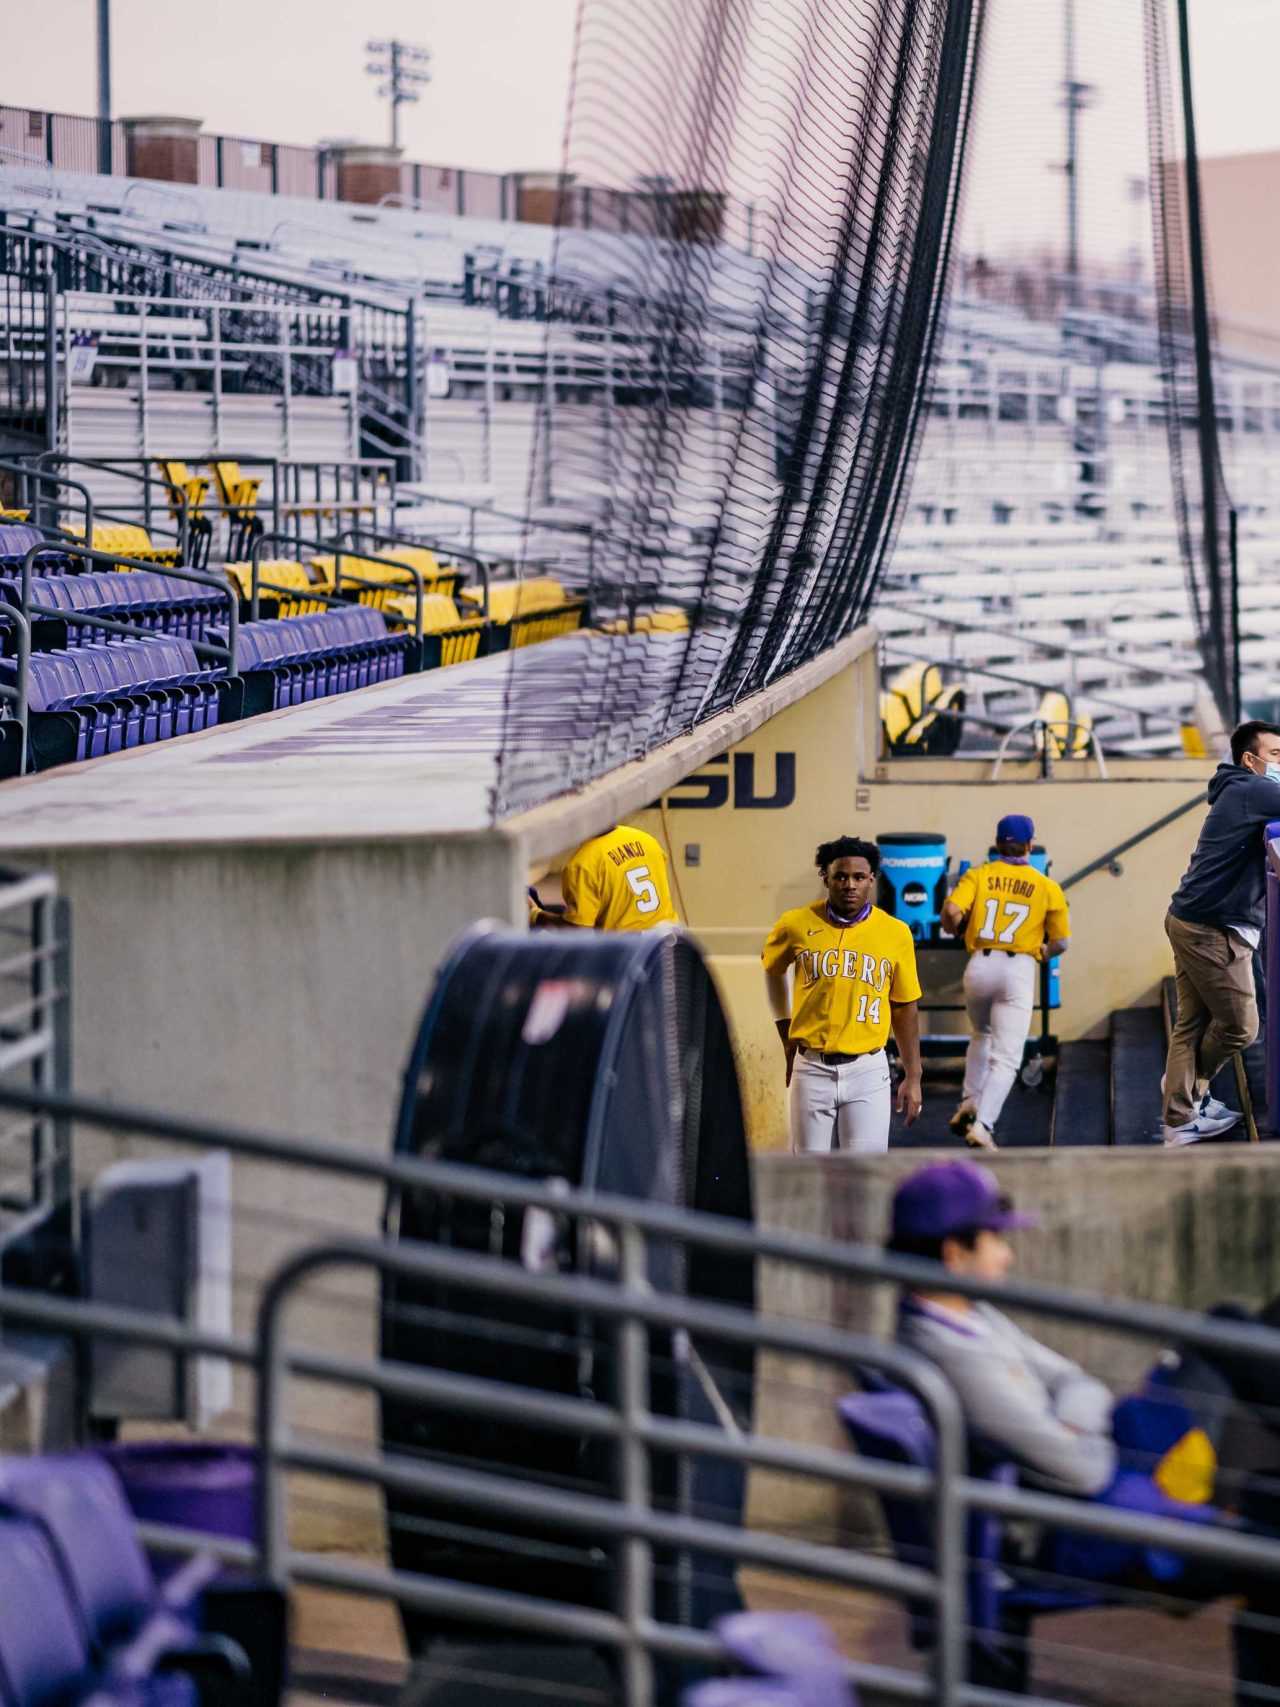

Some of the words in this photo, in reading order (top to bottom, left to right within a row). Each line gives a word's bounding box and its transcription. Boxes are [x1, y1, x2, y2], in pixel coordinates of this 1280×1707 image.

[643, 752, 796, 809] SU
[607, 841, 645, 867] BIANCO
[625, 864, 660, 913] 5
[987, 875, 1035, 898] SAFFORD
[979, 898, 1030, 945] 17
[796, 948, 892, 992] TIGERS
[856, 995, 881, 1024] 14
